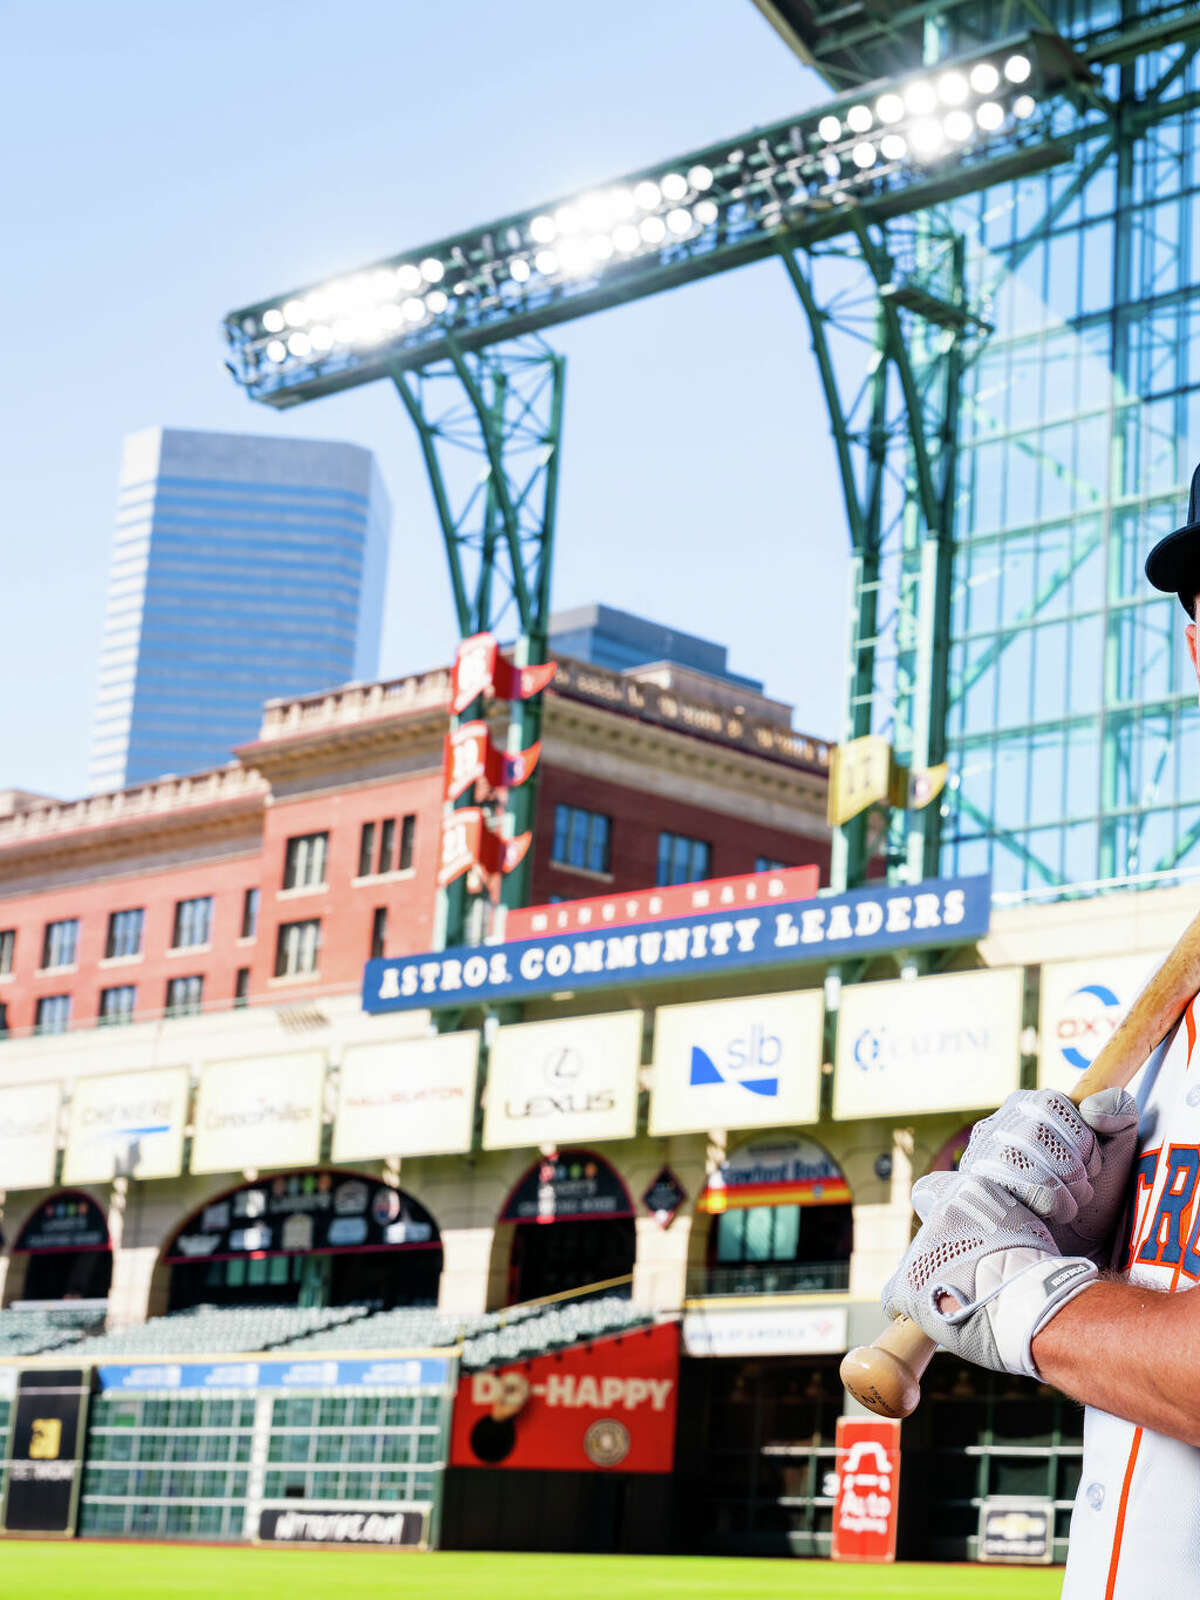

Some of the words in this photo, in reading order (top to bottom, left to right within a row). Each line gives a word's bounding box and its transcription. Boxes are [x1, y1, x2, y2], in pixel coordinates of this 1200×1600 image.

[531, 896, 663, 932] MINUTE
[692, 878, 785, 909] MAID
[378, 953, 507, 999] ASTROS
[520, 917, 761, 980] COMMUNITY
[774, 889, 966, 947] LEADERS
[727, 1024, 783, 1070] slb
[504, 1088, 616, 1119] LEXUS
